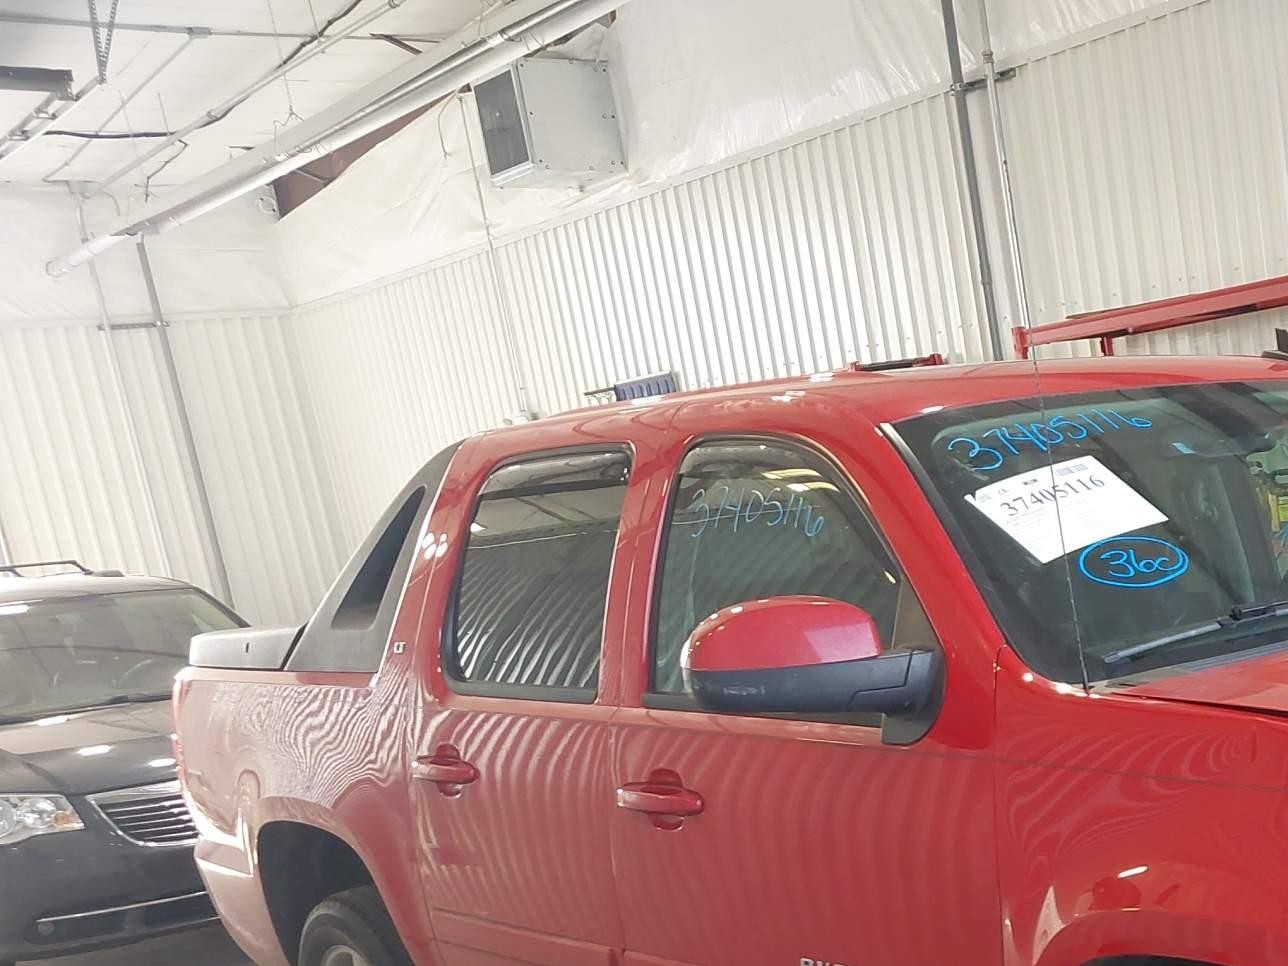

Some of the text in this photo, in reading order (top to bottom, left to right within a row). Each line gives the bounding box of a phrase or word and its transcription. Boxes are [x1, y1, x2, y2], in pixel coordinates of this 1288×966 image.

[948, 408, 1153, 471] 37405116
[691, 485, 825, 538] 37405116
[1000, 474, 1105, 517] 37405116
